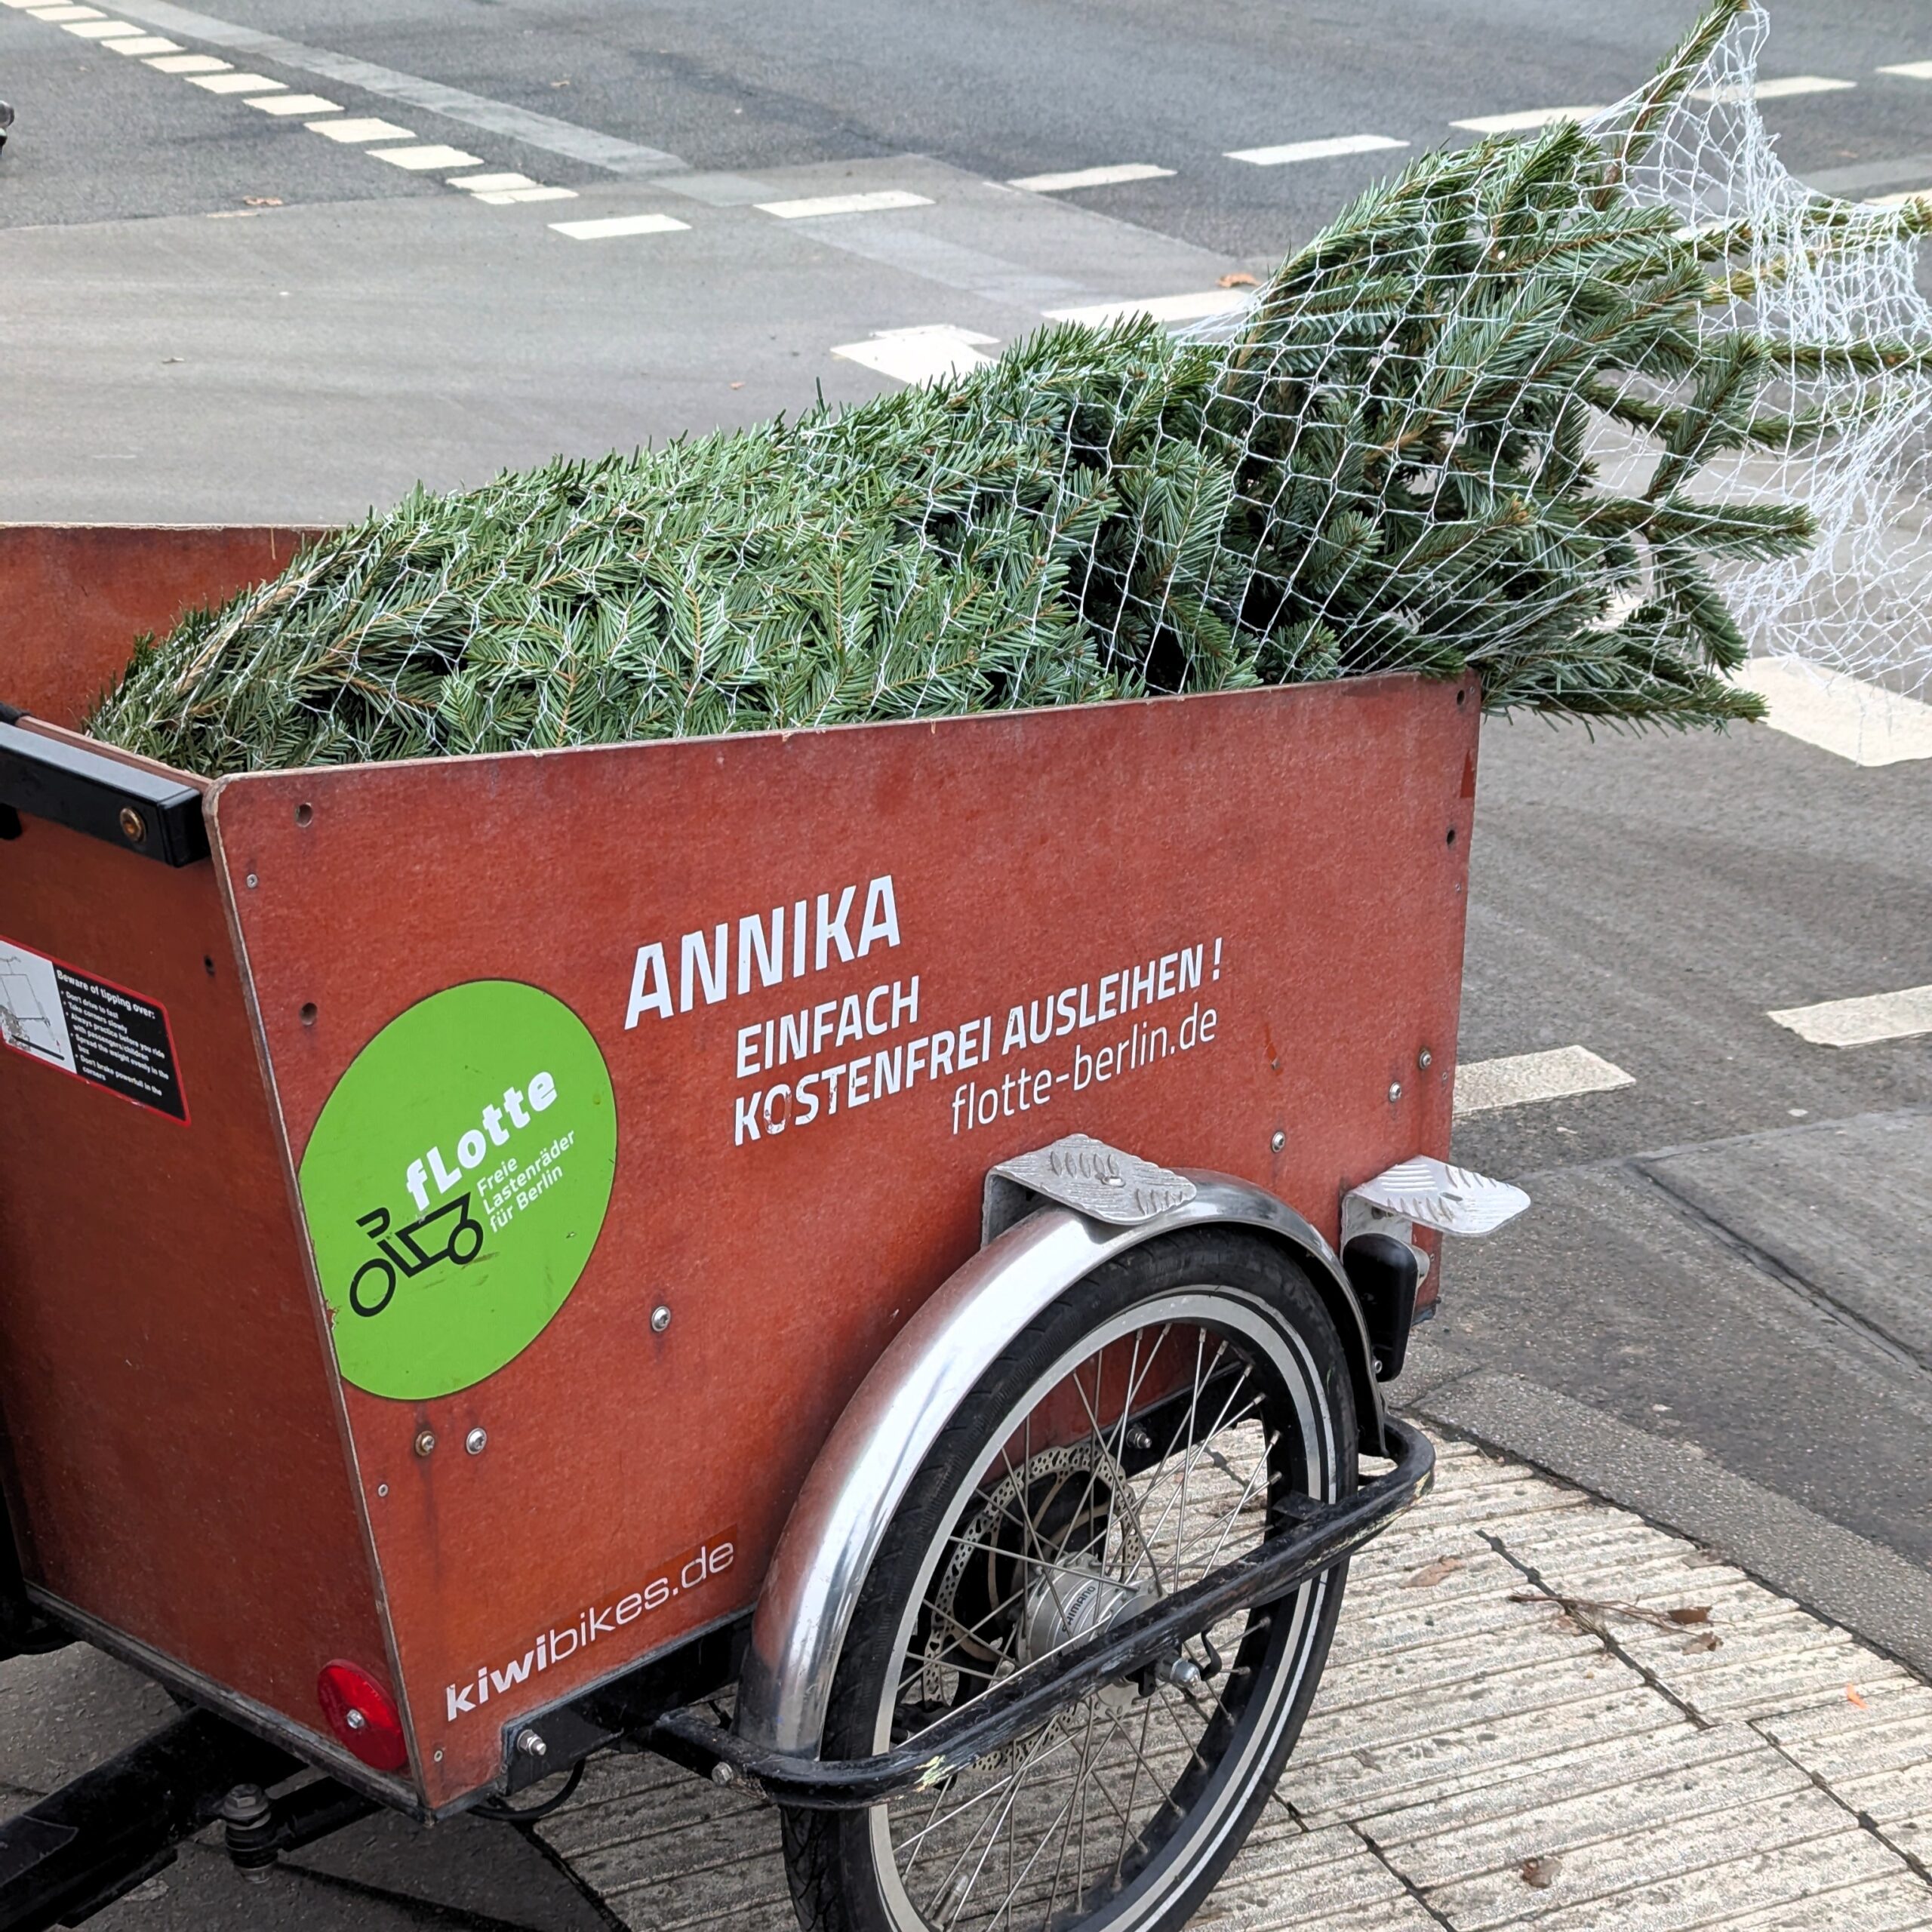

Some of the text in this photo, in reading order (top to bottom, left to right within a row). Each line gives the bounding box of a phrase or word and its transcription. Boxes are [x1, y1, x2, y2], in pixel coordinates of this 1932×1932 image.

[57, 969, 155, 1019] Beware of tipping over:
[624, 875, 900, 1030] ANNIKA
[108, 1020, 128, 1034] slowly
[734, 937, 1223, 1146] KOSTENFREI AUSLEIHEN !
[737, 975, 919, 1078] EINFACH
[952, 1008, 1218, 1135] flotte-berlin.de
[476, 1156, 518, 1198] Freie
[482, 1130, 575, 1216] Lastenräder
[490, 1164, 564, 1234] für Berlin
[446, 1541, 735, 1722] kiwibikes.de
